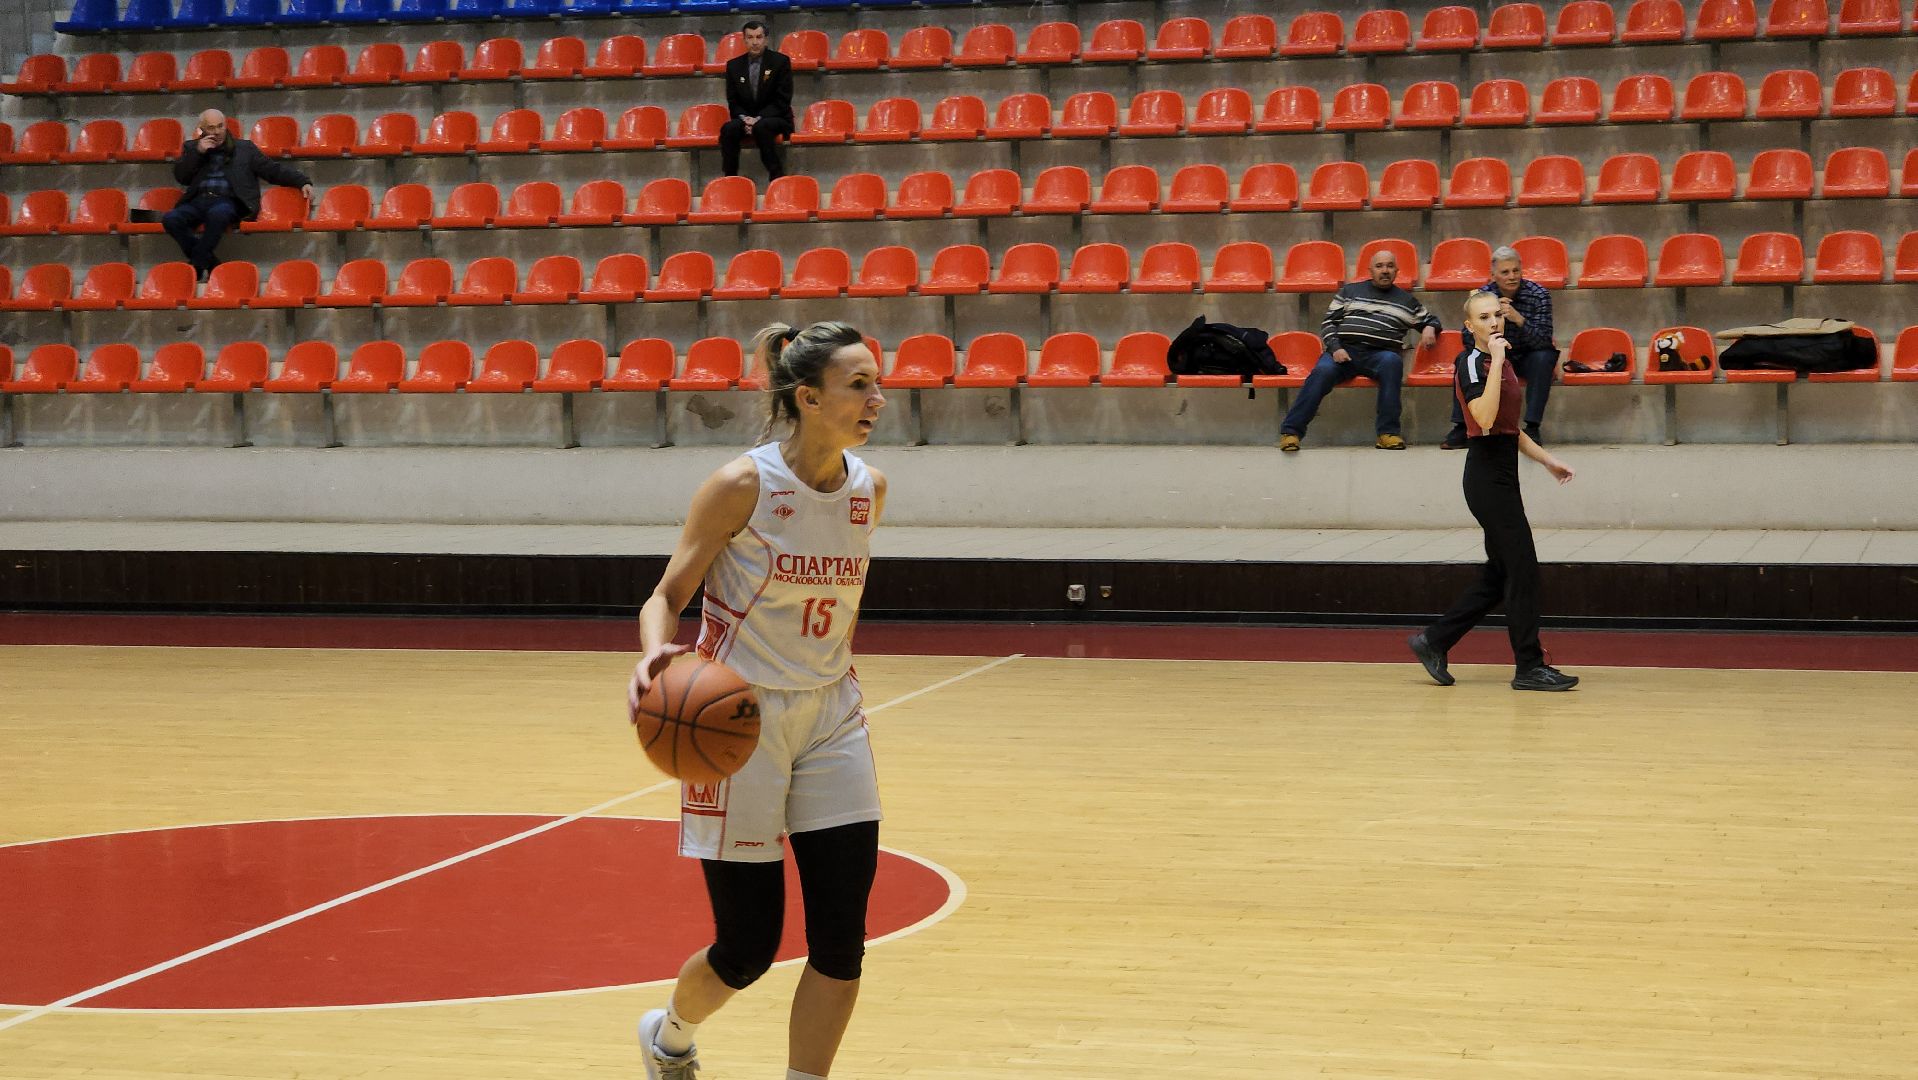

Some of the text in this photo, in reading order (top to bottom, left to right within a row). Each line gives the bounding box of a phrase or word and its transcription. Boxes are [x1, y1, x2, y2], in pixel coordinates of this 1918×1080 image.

[852, 500, 869, 511] FON
[852, 510, 868, 521] BET
[776, 553, 863, 577] СПАРТАК
[773, 573, 832, 586] МОСКОВСКАЯ
[801, 597, 838, 639] 15
